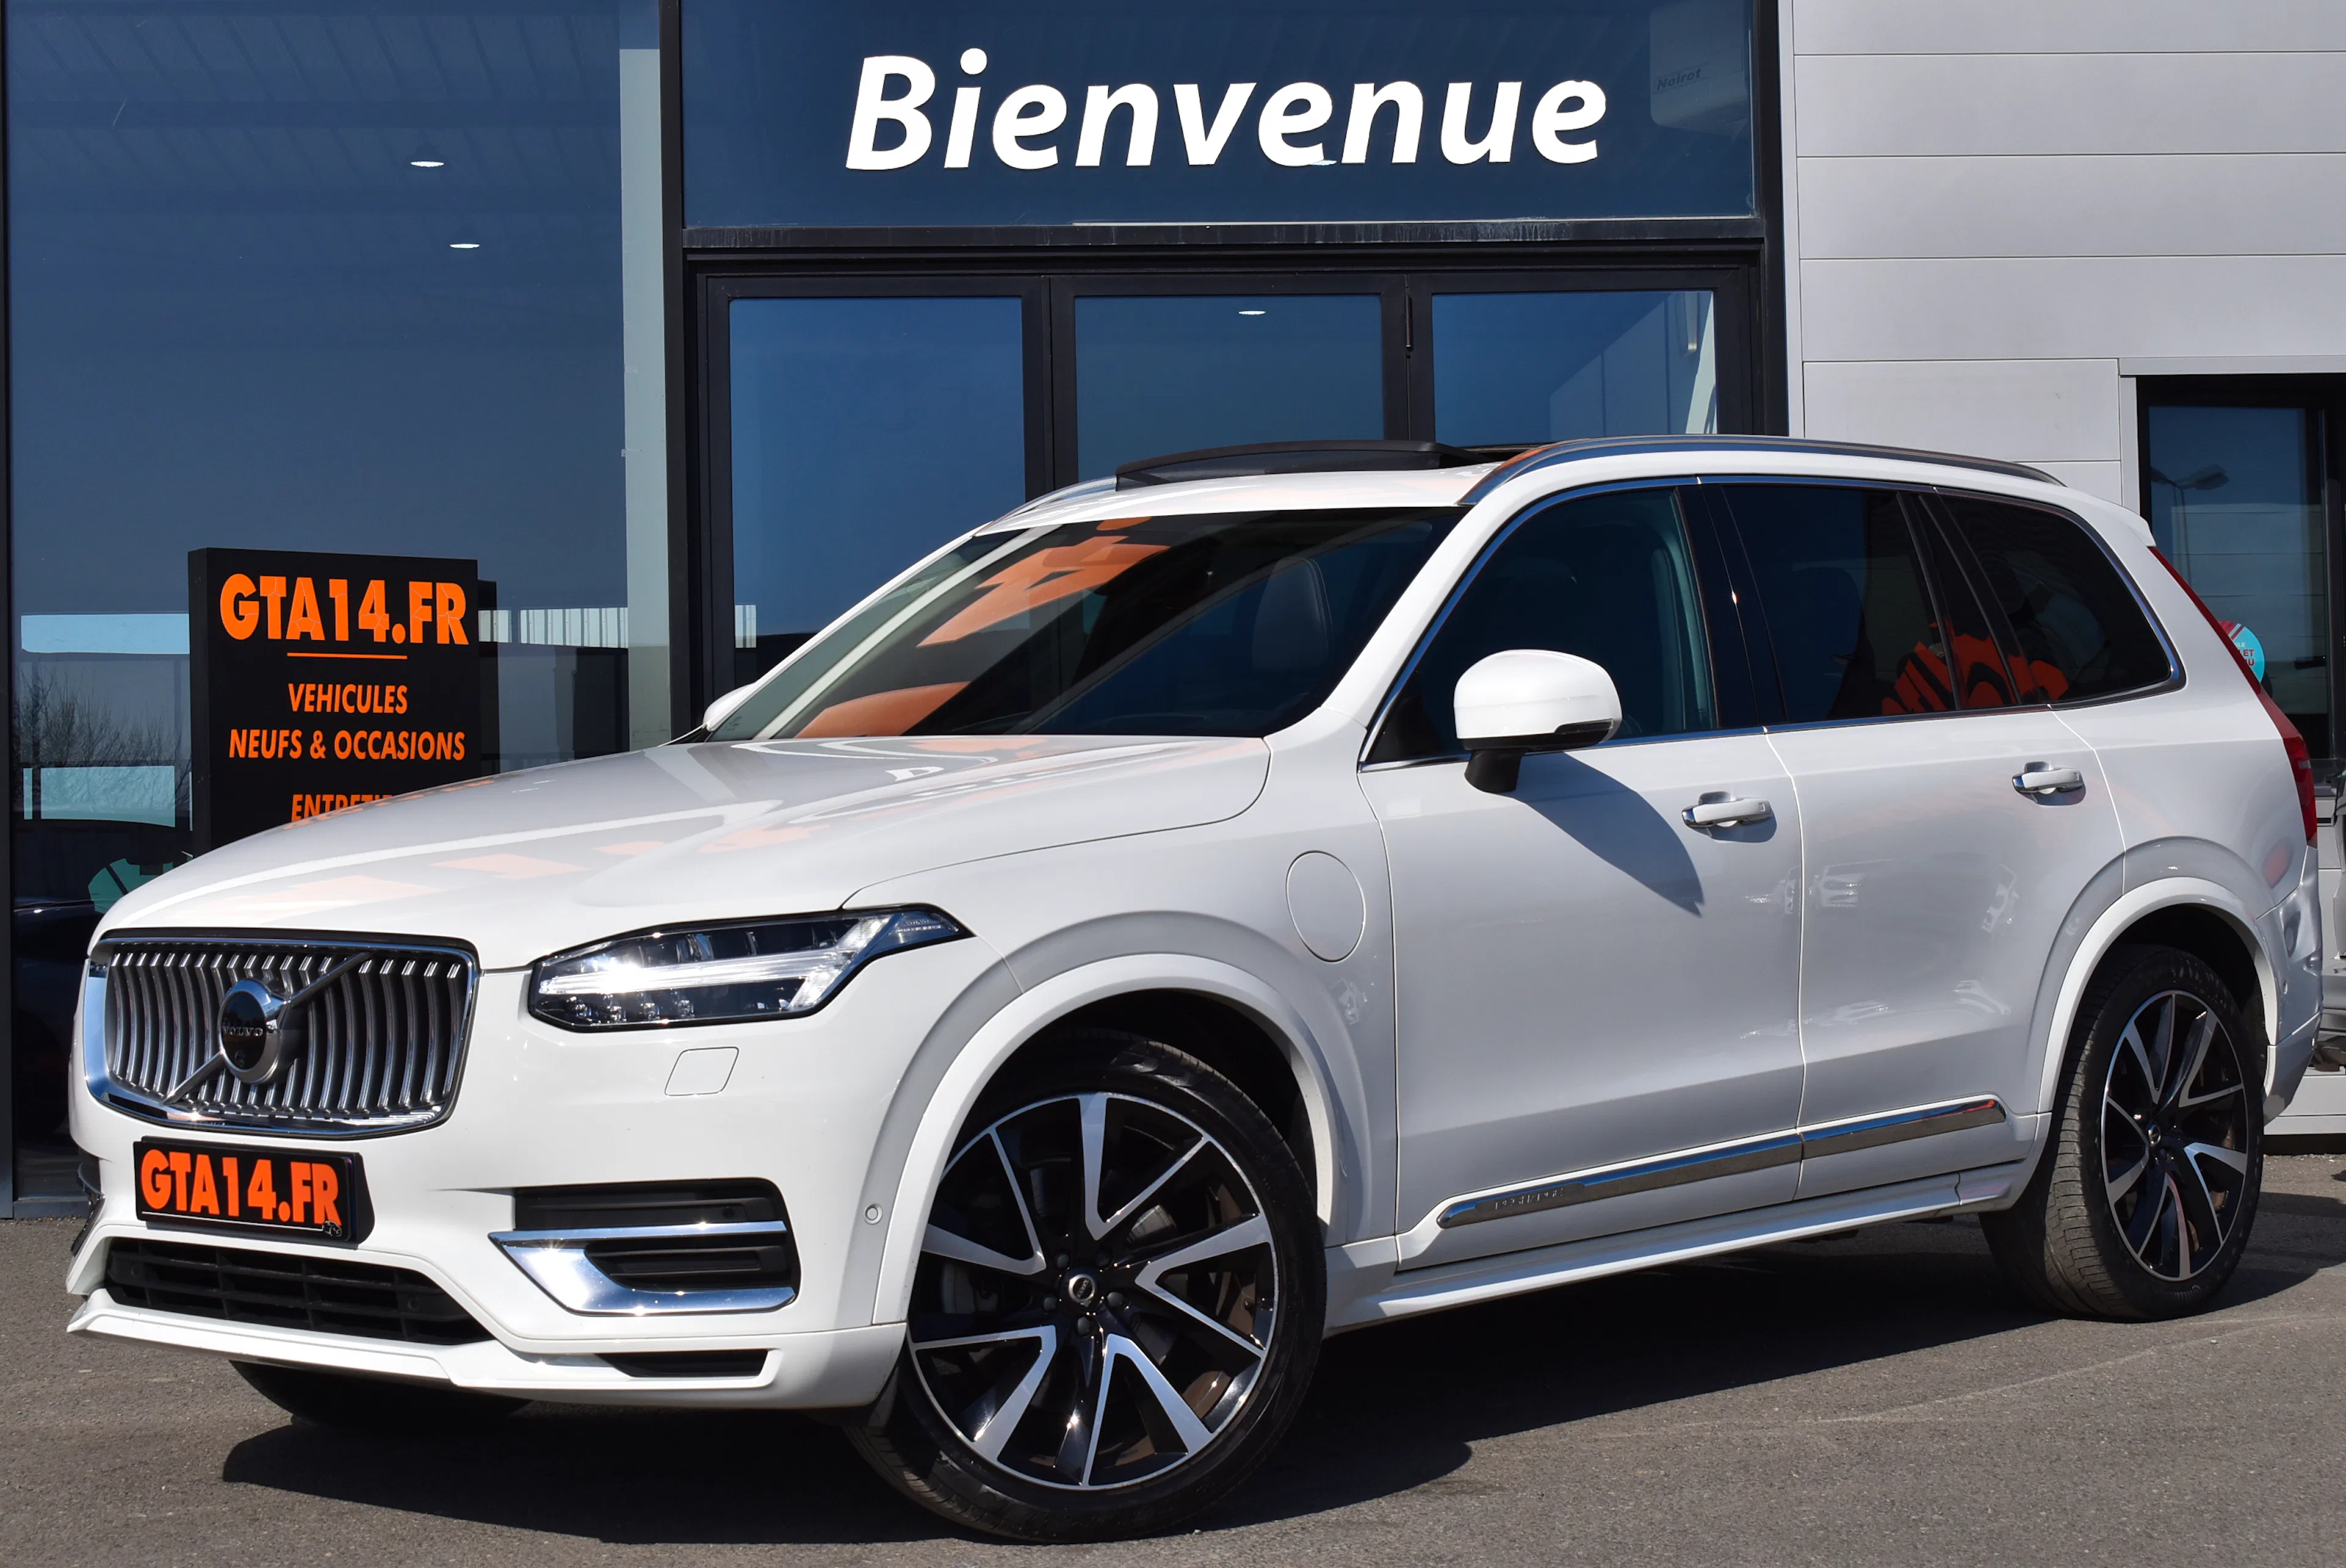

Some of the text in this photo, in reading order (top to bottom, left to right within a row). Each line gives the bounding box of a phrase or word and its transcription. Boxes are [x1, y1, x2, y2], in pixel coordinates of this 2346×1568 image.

[1657, 68, 1701, 90] Noirot
[846, 48, 1607, 170] Bienvenue
[220, 574, 469, 645] GTA14.FR
[288, 683, 407, 714] VEHICULES
[229, 729, 466, 760] NEUFS & OCCASIONS
[291, 794, 393, 822] ENTR
[222, 1026, 263, 1037] VOLVO
[141, 1149, 342, 1226] GTA14.FR
